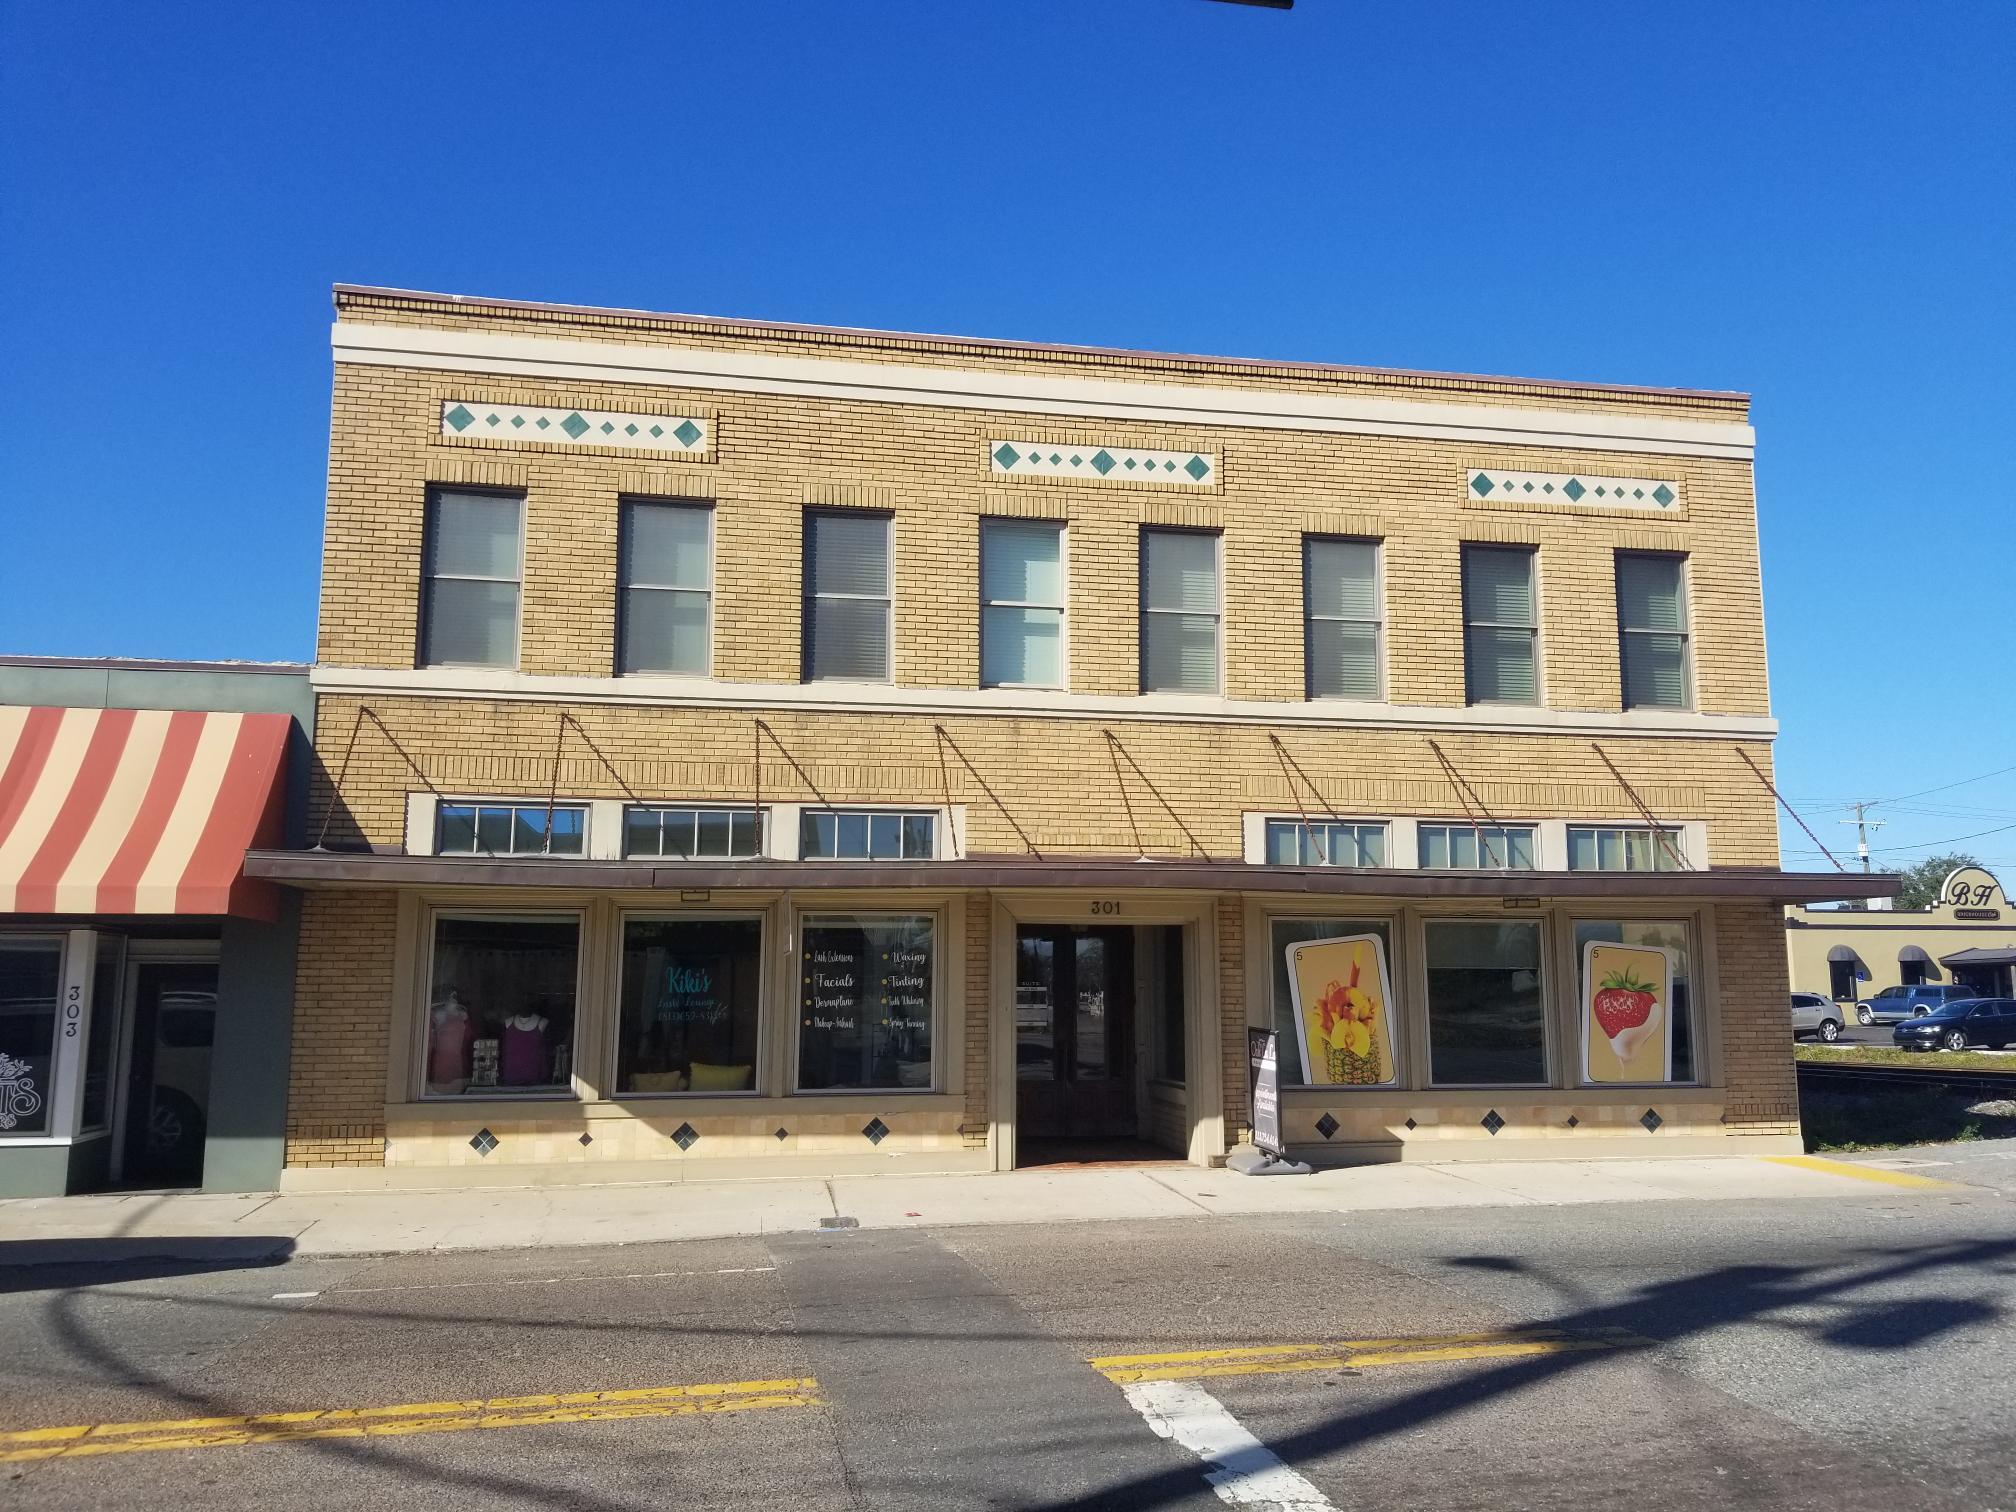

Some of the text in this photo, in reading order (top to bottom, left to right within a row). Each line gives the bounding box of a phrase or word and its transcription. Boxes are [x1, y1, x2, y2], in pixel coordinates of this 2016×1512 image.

[1091, 901, 1120, 915] 301
[891, 951, 926, 965] Waxing
[1296, 951, 1303, 961] 5
[1593, 950, 1599, 959] 5
[666, 966, 713, 994] Kiki's
[814, 973, 854, 988] Facials
[888, 975, 924, 989] Tinting
[65, 986, 81, 1038] 303
